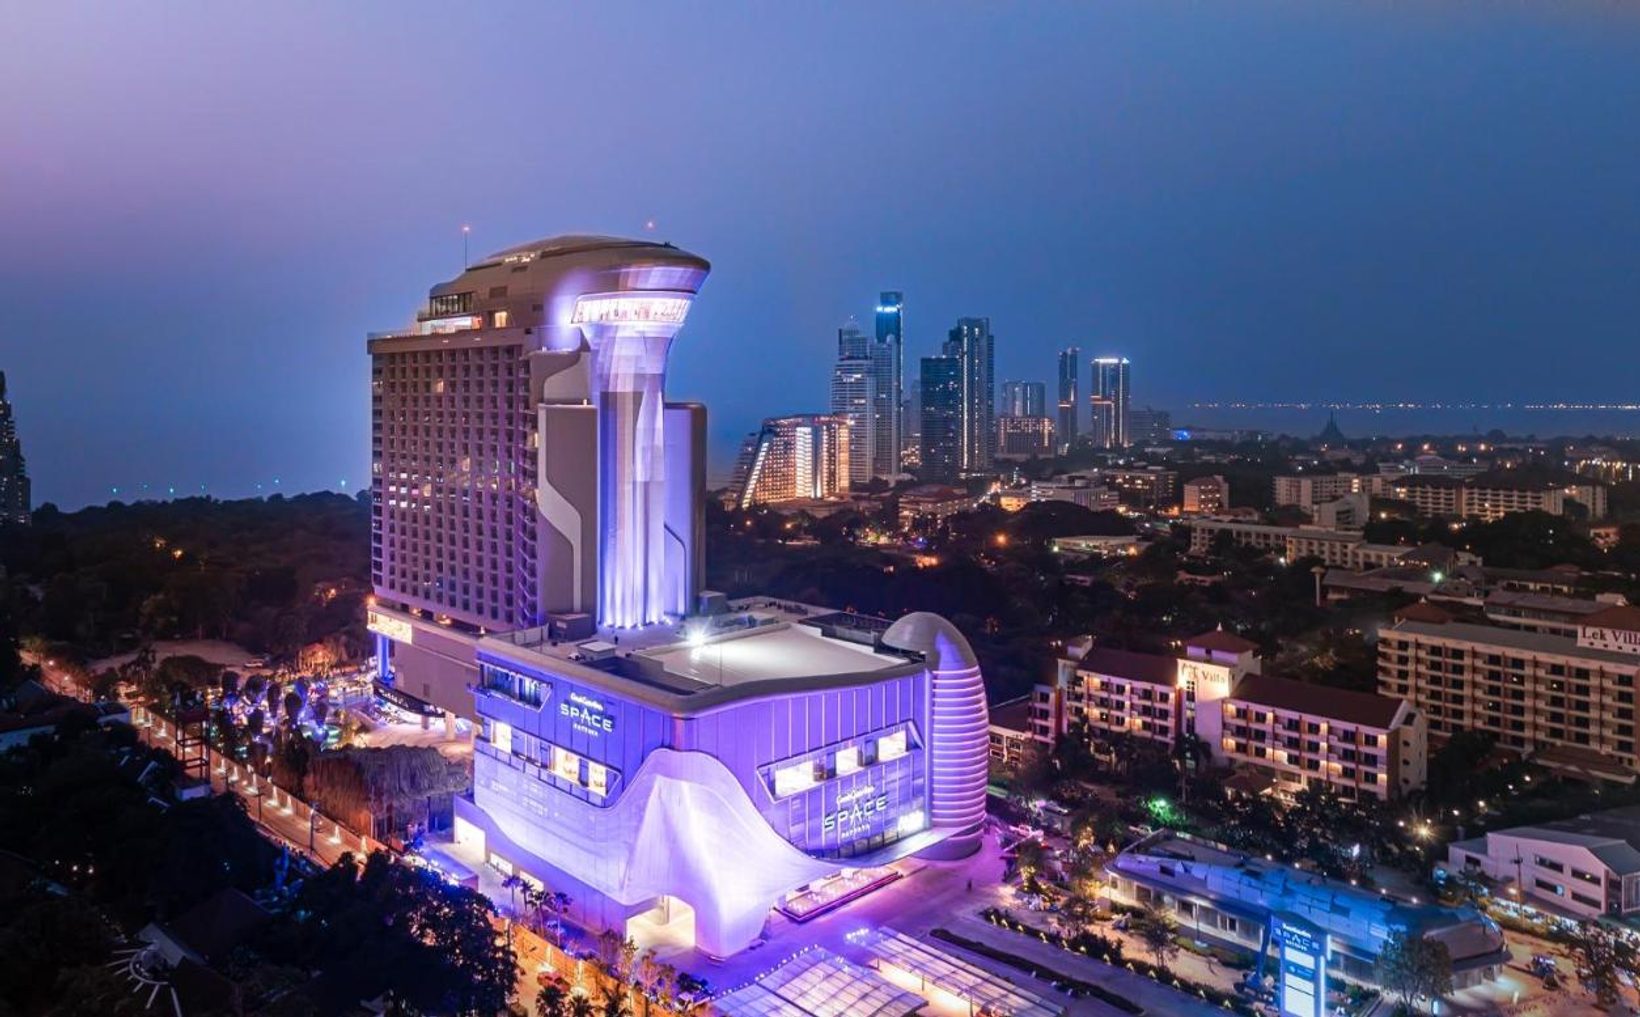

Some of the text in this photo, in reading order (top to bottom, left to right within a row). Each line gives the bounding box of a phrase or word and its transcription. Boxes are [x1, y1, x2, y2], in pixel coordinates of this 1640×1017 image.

[1582, 626, 1608, 641] Lek
[560, 702, 613, 733] SPACE
[824, 794, 889, 833] SPACE
